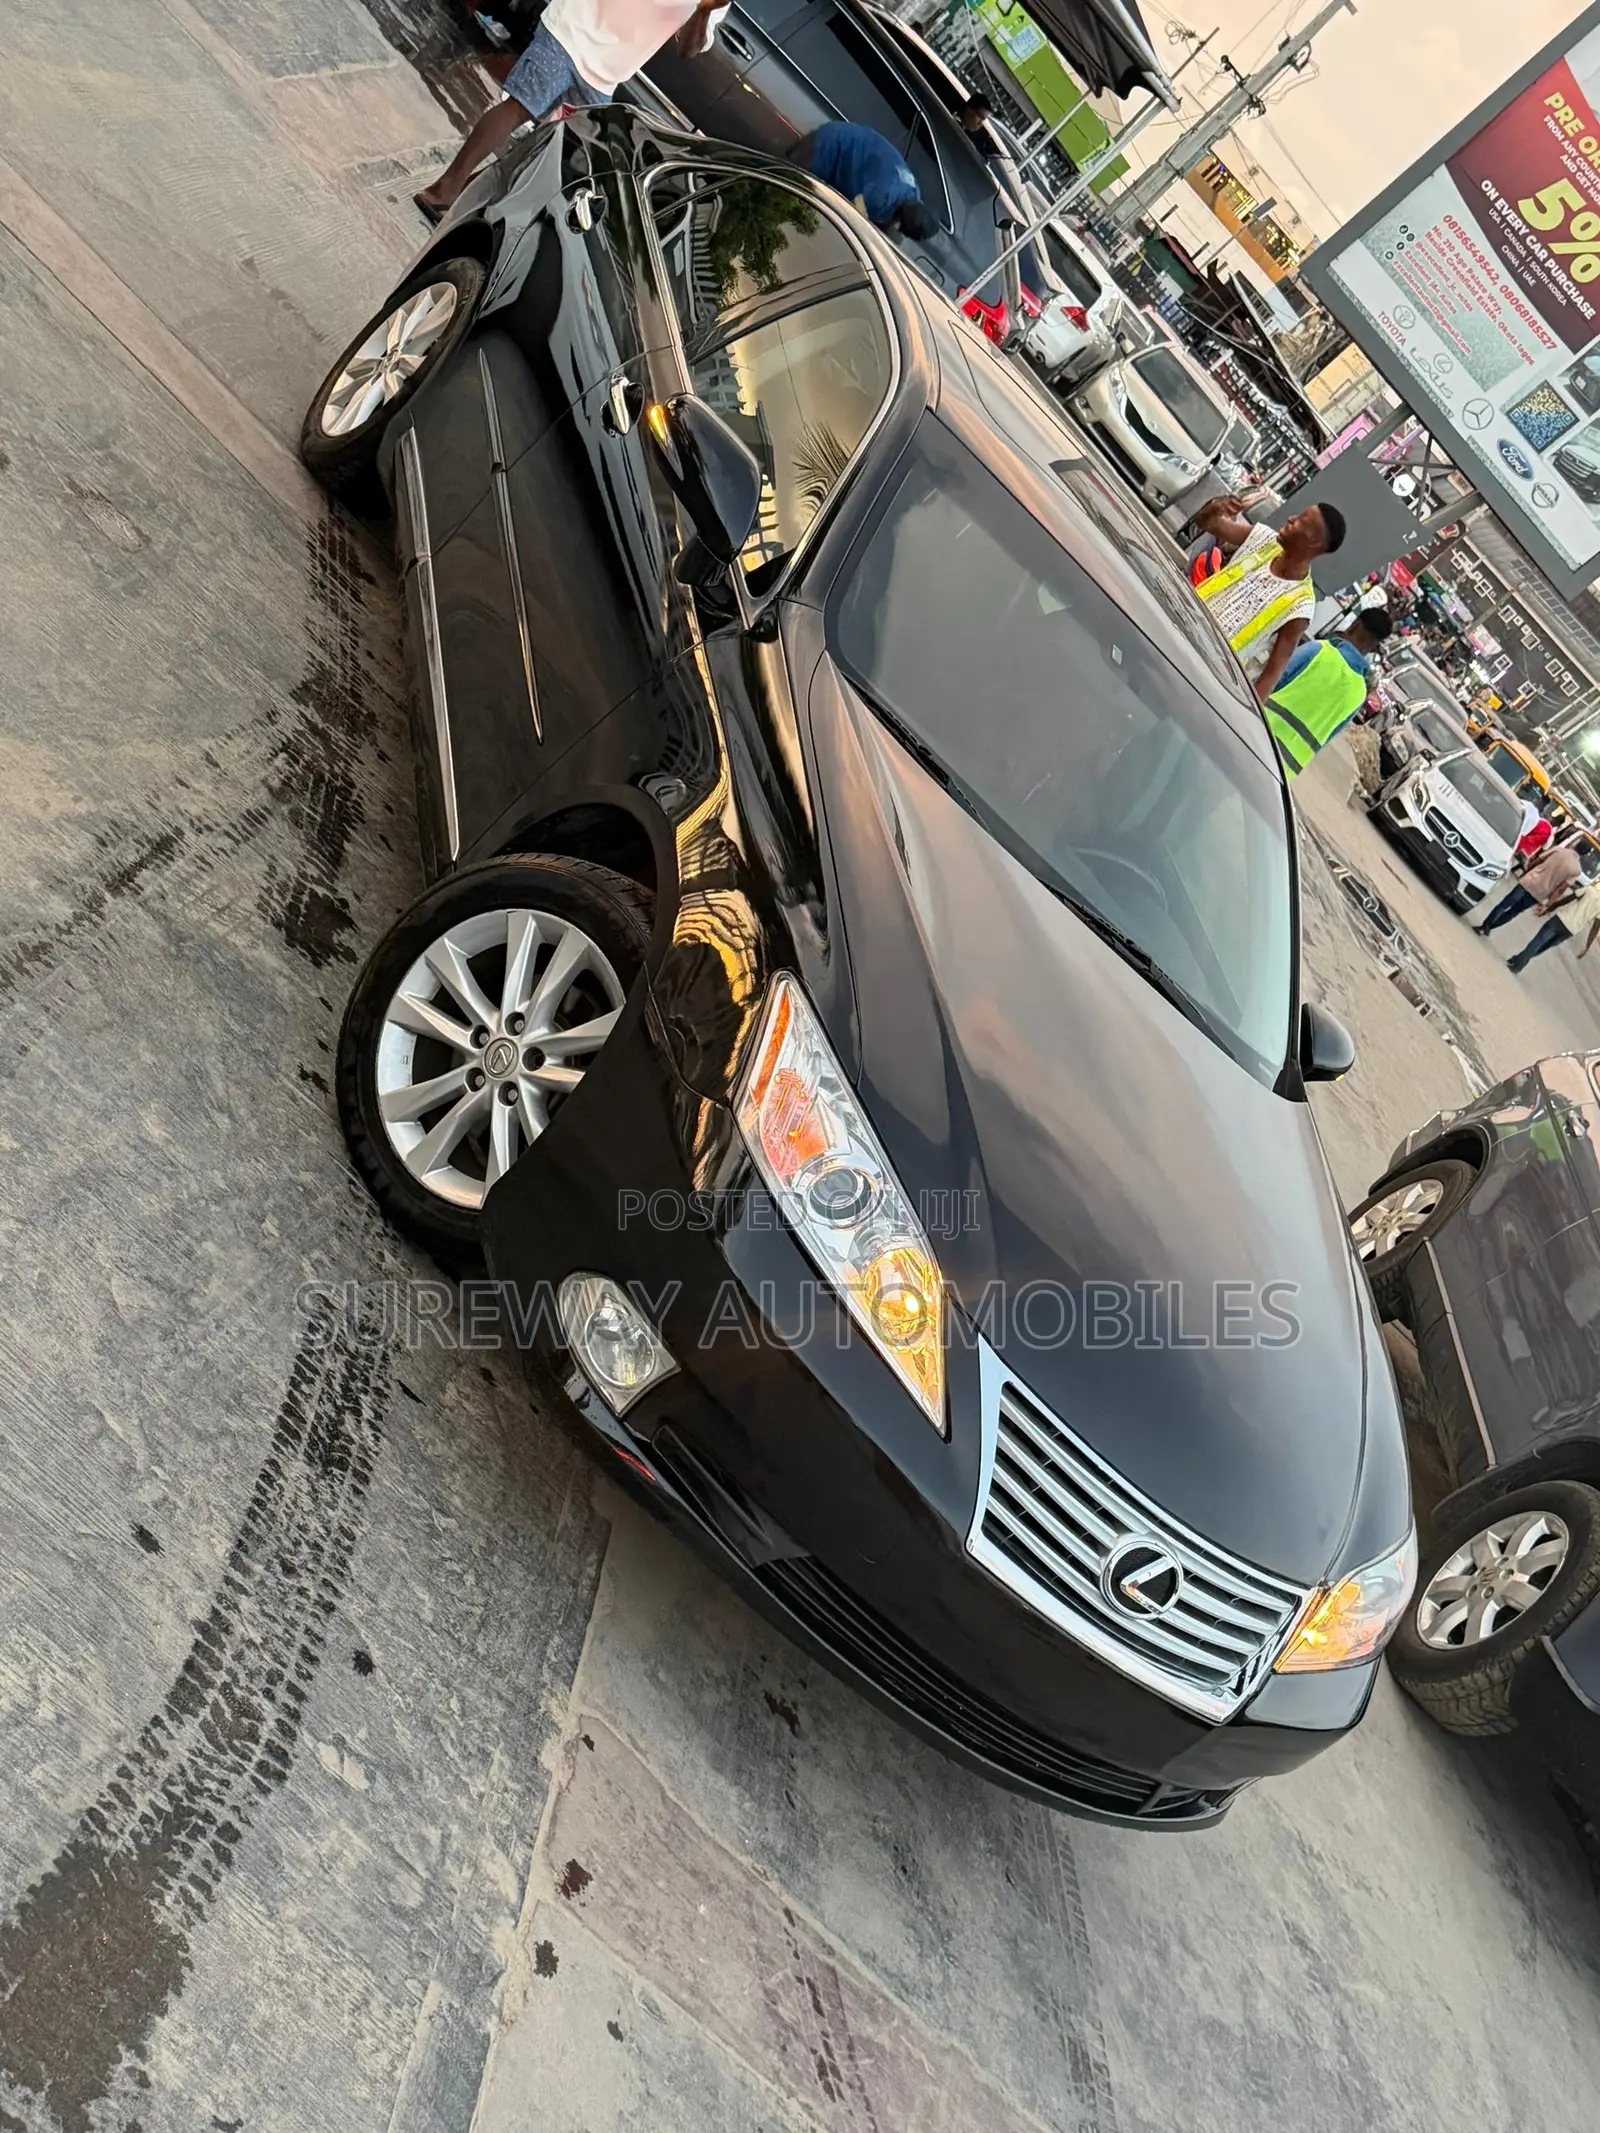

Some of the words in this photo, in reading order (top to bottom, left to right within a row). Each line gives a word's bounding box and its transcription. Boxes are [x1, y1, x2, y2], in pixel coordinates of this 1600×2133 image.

[1543, 91, 1586, 137] PRE
[1543, 114, 1565, 141] FROM
[1561, 140, 1579, 158] ANY
[1560, 154, 1578, 173] AND
[1575, 171, 1592, 188] GET
[1481, 180, 1499, 201] ON
[1494, 198, 1530, 238] EVERY
[1525, 235, 1548, 262] CAR
[1544, 258, 1596, 320] PURCHASE
[1517, 177, 1600, 284] 5%
[1404, 250, 1432, 281] Excellent
[1453, 252, 1468, 269] Ago
[1466, 267, 1488, 294] Palace
[1488, 208, 1501, 224] USA
[1503, 228, 1528, 258] CANADA
[1529, 261, 1551, 284] SOUTH
[1547, 280, 1568, 307] KOREA
[1501, 245, 1520, 268] CHINA
[1522, 270, 1536, 287] UAE
[1446, 257, 1479, 297] Greenfield
[1498, 321, 1518, 346] Okota
[1499, 284, 1558, 350] 08068185527
[1378, 310, 1407, 346] TOYOTA
[1409, 347, 1454, 399] LEXUS
[1501, 446, 1529, 474] Ford
